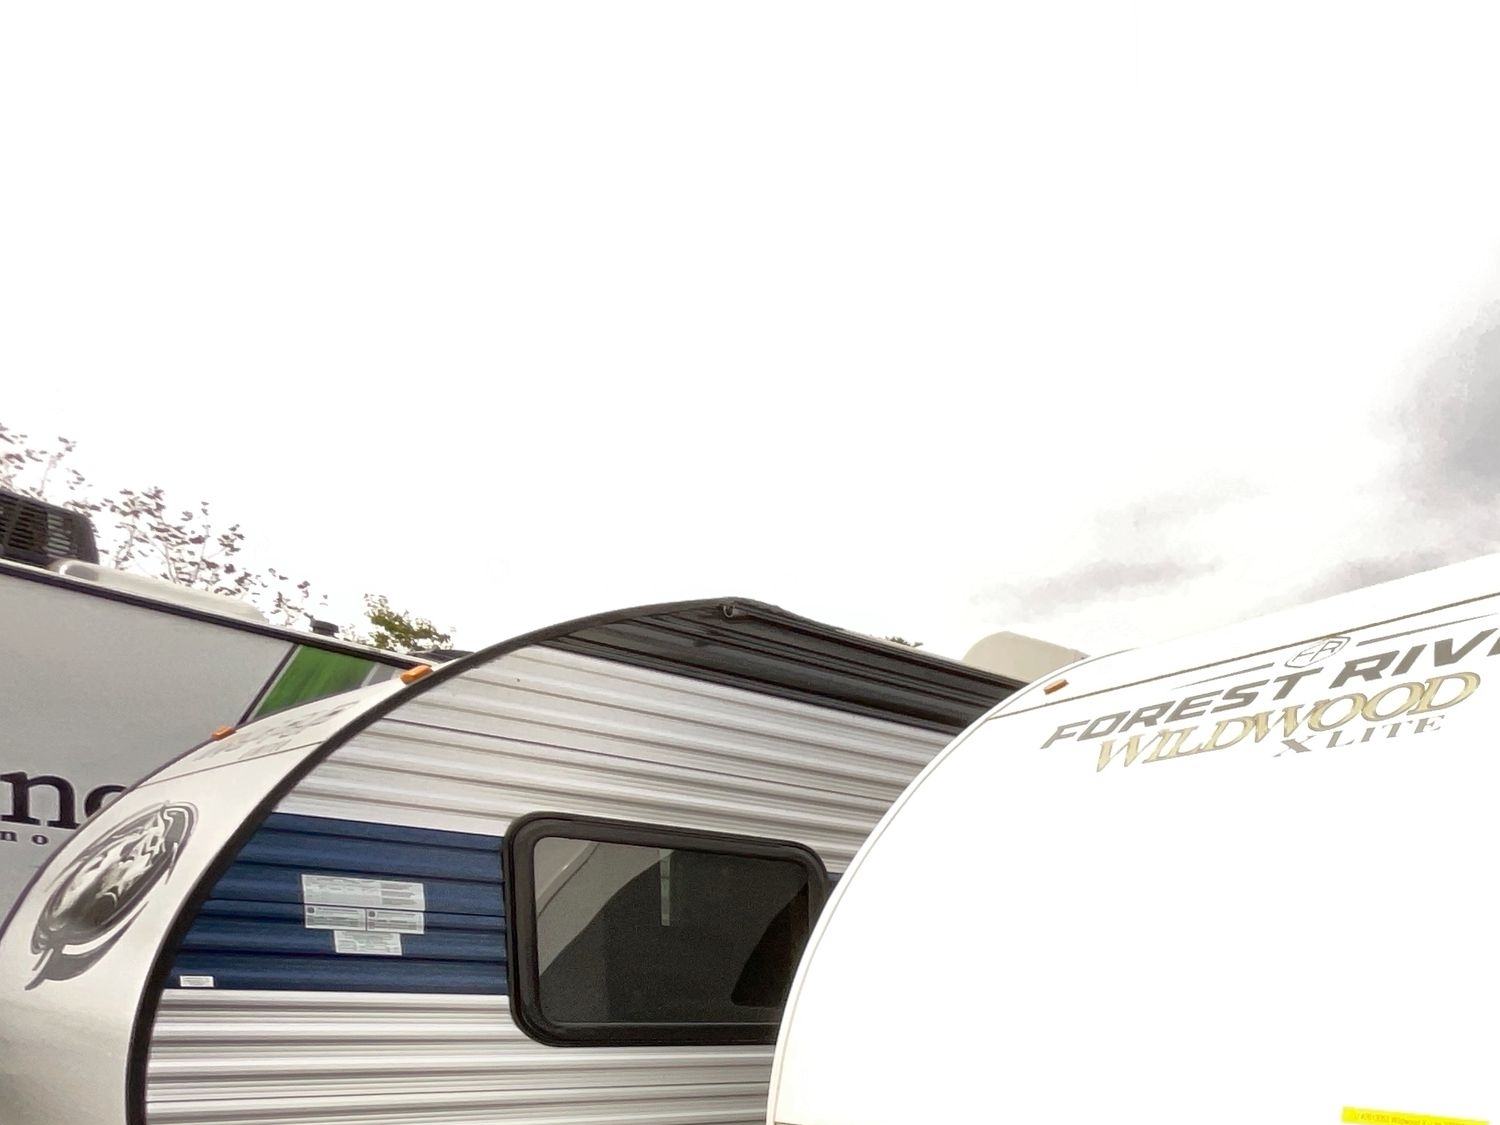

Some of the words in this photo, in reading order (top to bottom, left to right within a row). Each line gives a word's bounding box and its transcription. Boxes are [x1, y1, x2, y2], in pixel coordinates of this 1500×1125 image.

[1040, 667, 1322, 750] FOREST
[1096, 671, 1482, 773] WILDWOOD
[1326, 715, 1446, 749] LITE
